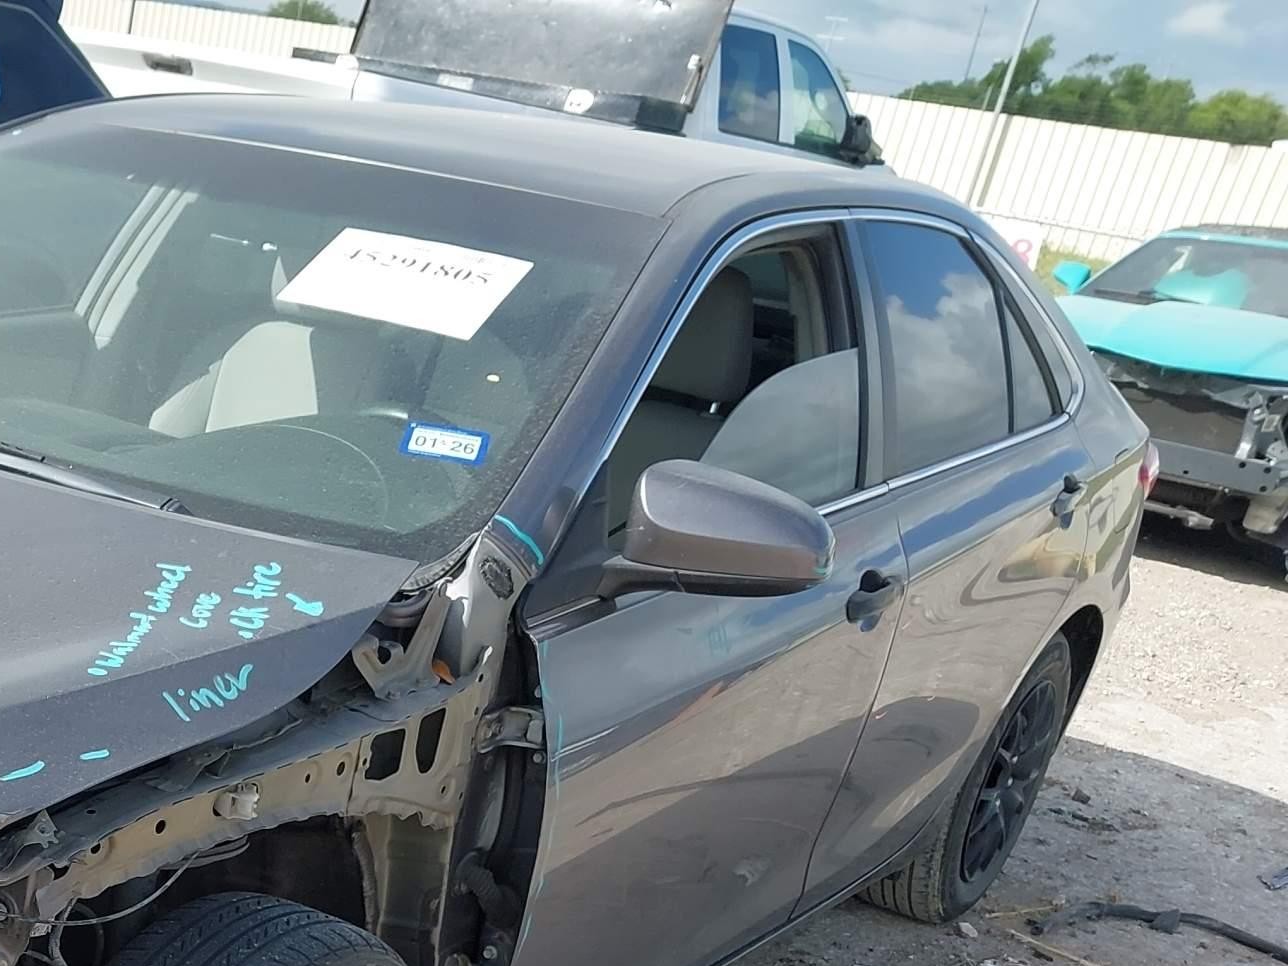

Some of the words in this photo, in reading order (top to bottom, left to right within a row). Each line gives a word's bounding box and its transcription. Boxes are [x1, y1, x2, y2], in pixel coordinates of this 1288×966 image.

[347, 247, 494, 285] 45291805
[414, 435, 439, 449] 01
[450, 440, 475, 455] 26
